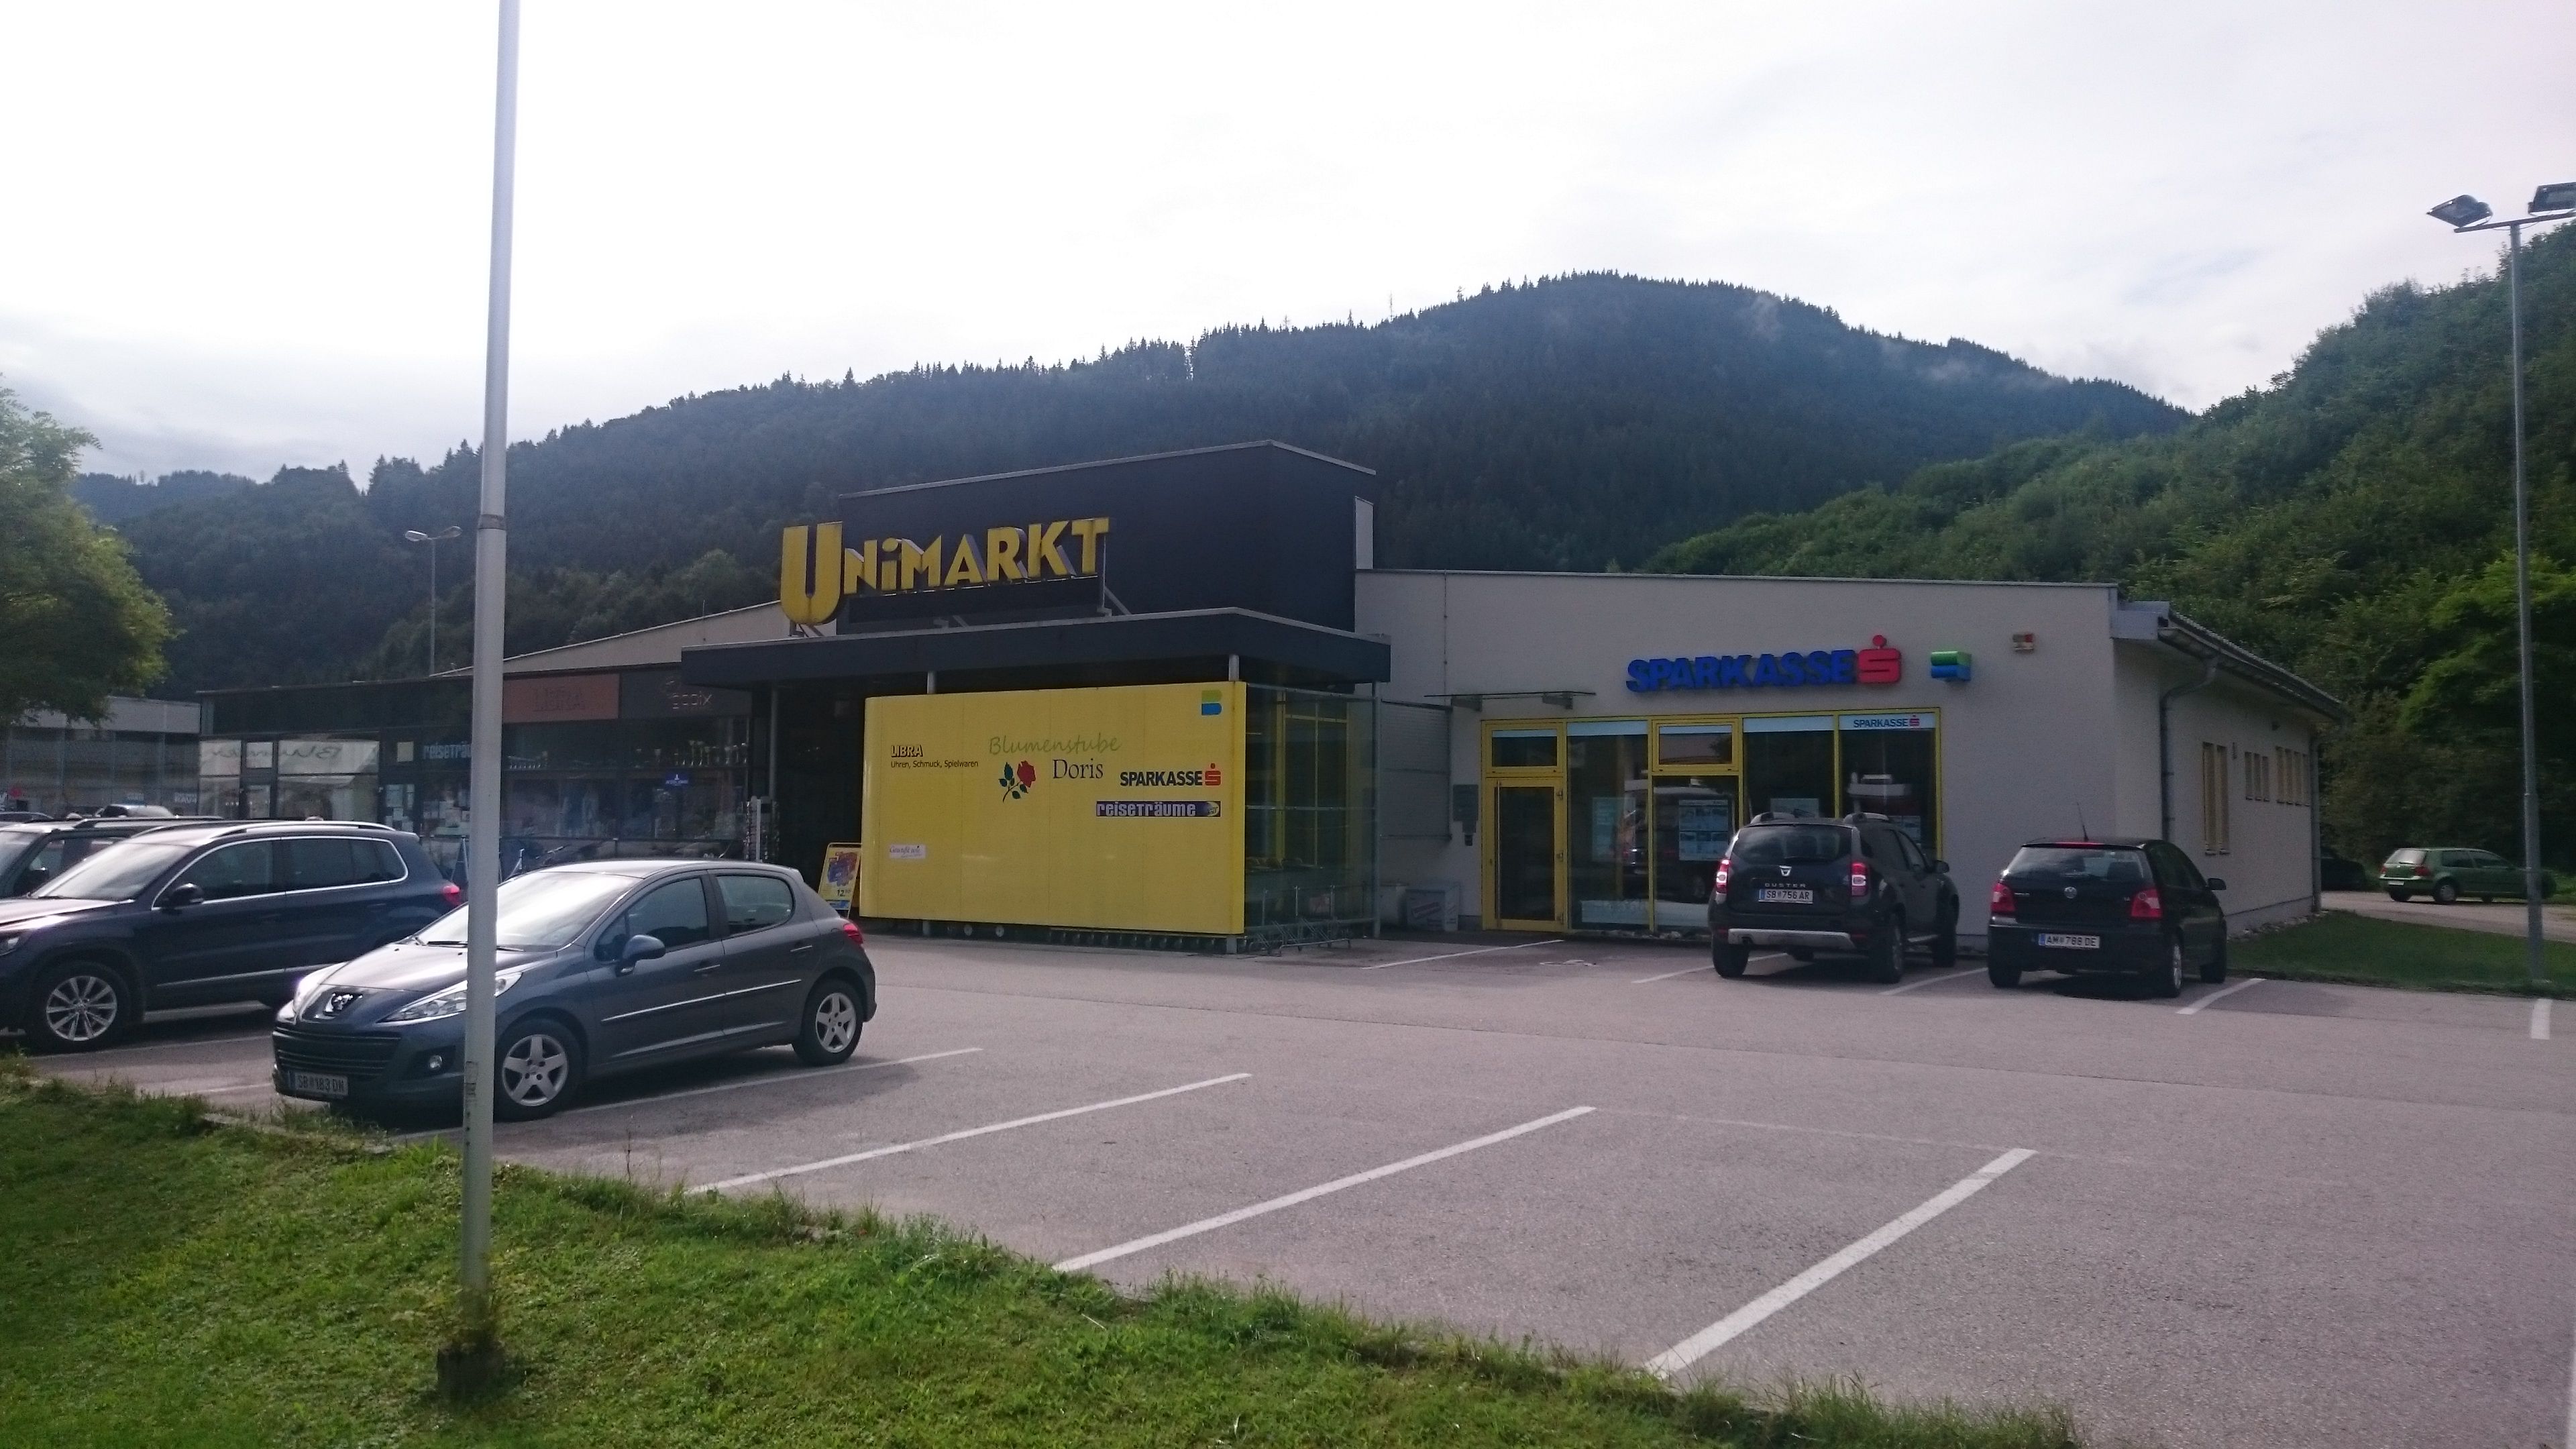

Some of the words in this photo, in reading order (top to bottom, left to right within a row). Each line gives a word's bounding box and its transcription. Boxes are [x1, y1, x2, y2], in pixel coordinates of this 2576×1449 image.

[1626, 649, 1856, 692] SPARKASSE
[1854, 718, 1909, 728] SPARKASSE
[890, 745, 923, 757] LIBRA
[989, 733, 1122, 755] Blumenstube
[891, 761, 911, 769] Uhren,
[913, 760, 942, 768] Schmuck,
[944, 759, 979, 769] Spielwaren
[1053, 758, 1104, 779] Doris
[1120, 771, 1203, 786] SPARKASSE
